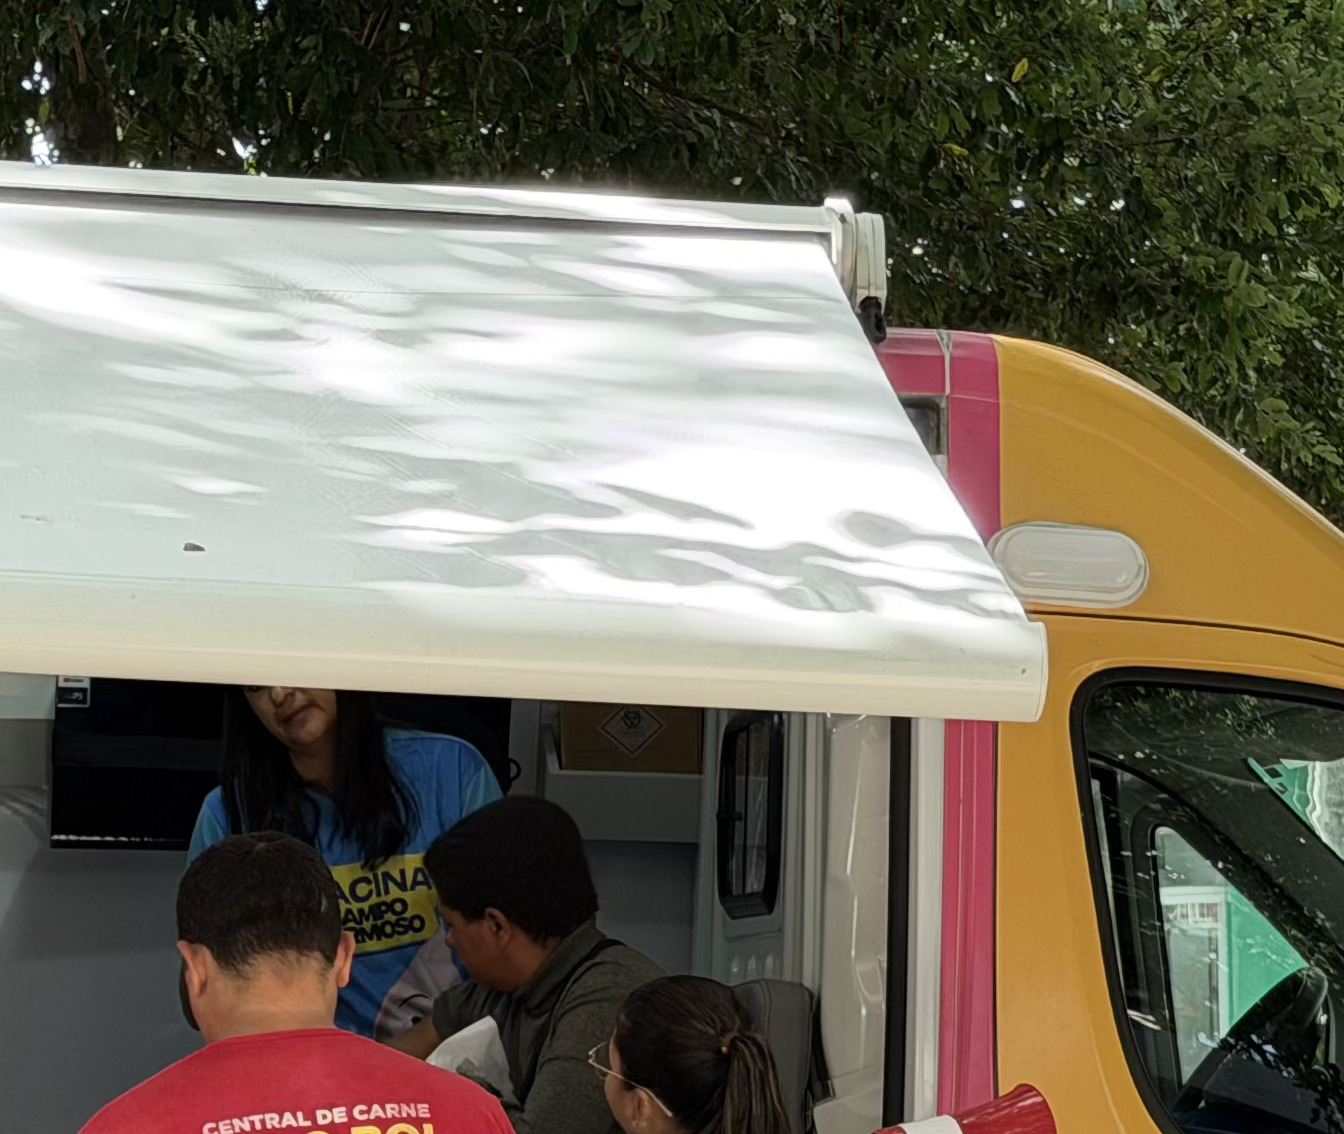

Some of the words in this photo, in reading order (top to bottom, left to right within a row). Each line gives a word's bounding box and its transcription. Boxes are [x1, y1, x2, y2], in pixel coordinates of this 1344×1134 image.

[336, 867, 432, 905] ACINA
[342, 898, 409, 927] AMPO
[316, 1107, 348, 1125] DE
[352, 1103, 431, 1121] CARNE
